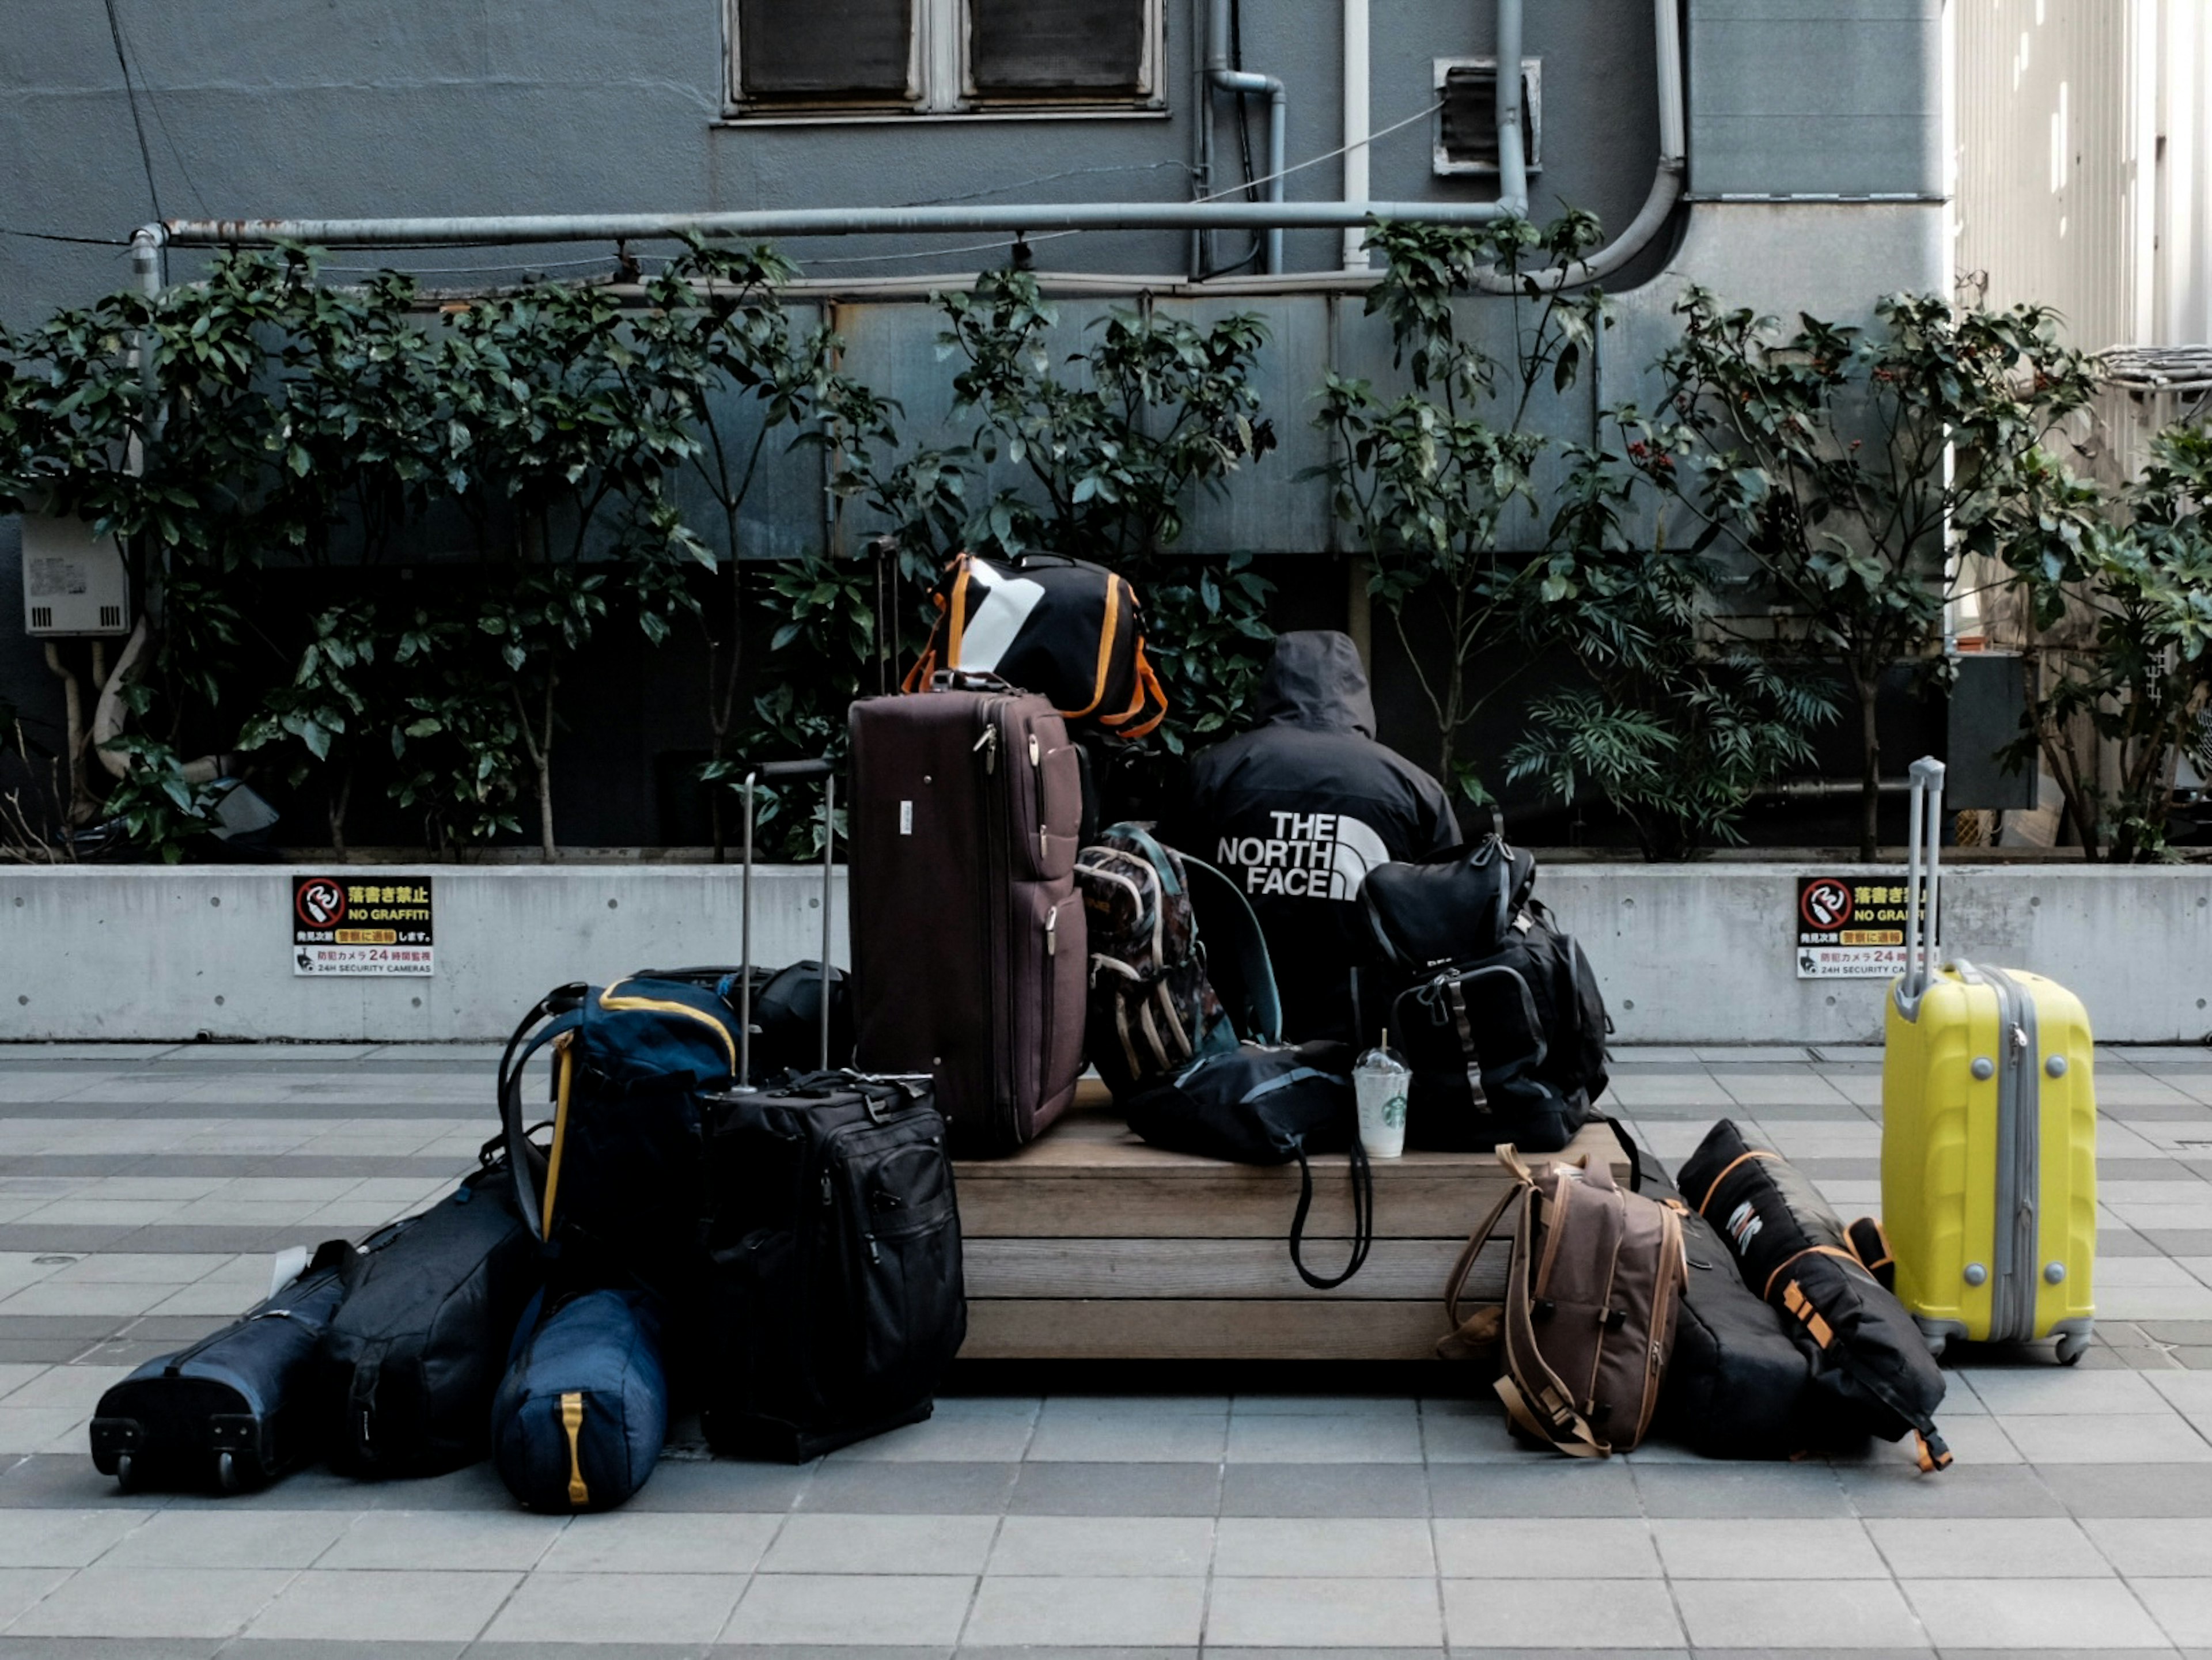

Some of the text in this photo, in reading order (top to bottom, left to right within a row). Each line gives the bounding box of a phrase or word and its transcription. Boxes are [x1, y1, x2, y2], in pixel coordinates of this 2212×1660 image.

[1270, 810, 1336, 841] THE
[1217, 836, 1334, 870] NORTH
[1247, 866, 1328, 898] FACE
[348, 886, 428, 903] 落書き禁止
[1854, 886, 1926, 903] 落書き
[349, 909, 429, 920] NO GRAFFITI
[1855, 910, 1874, 920] NO
